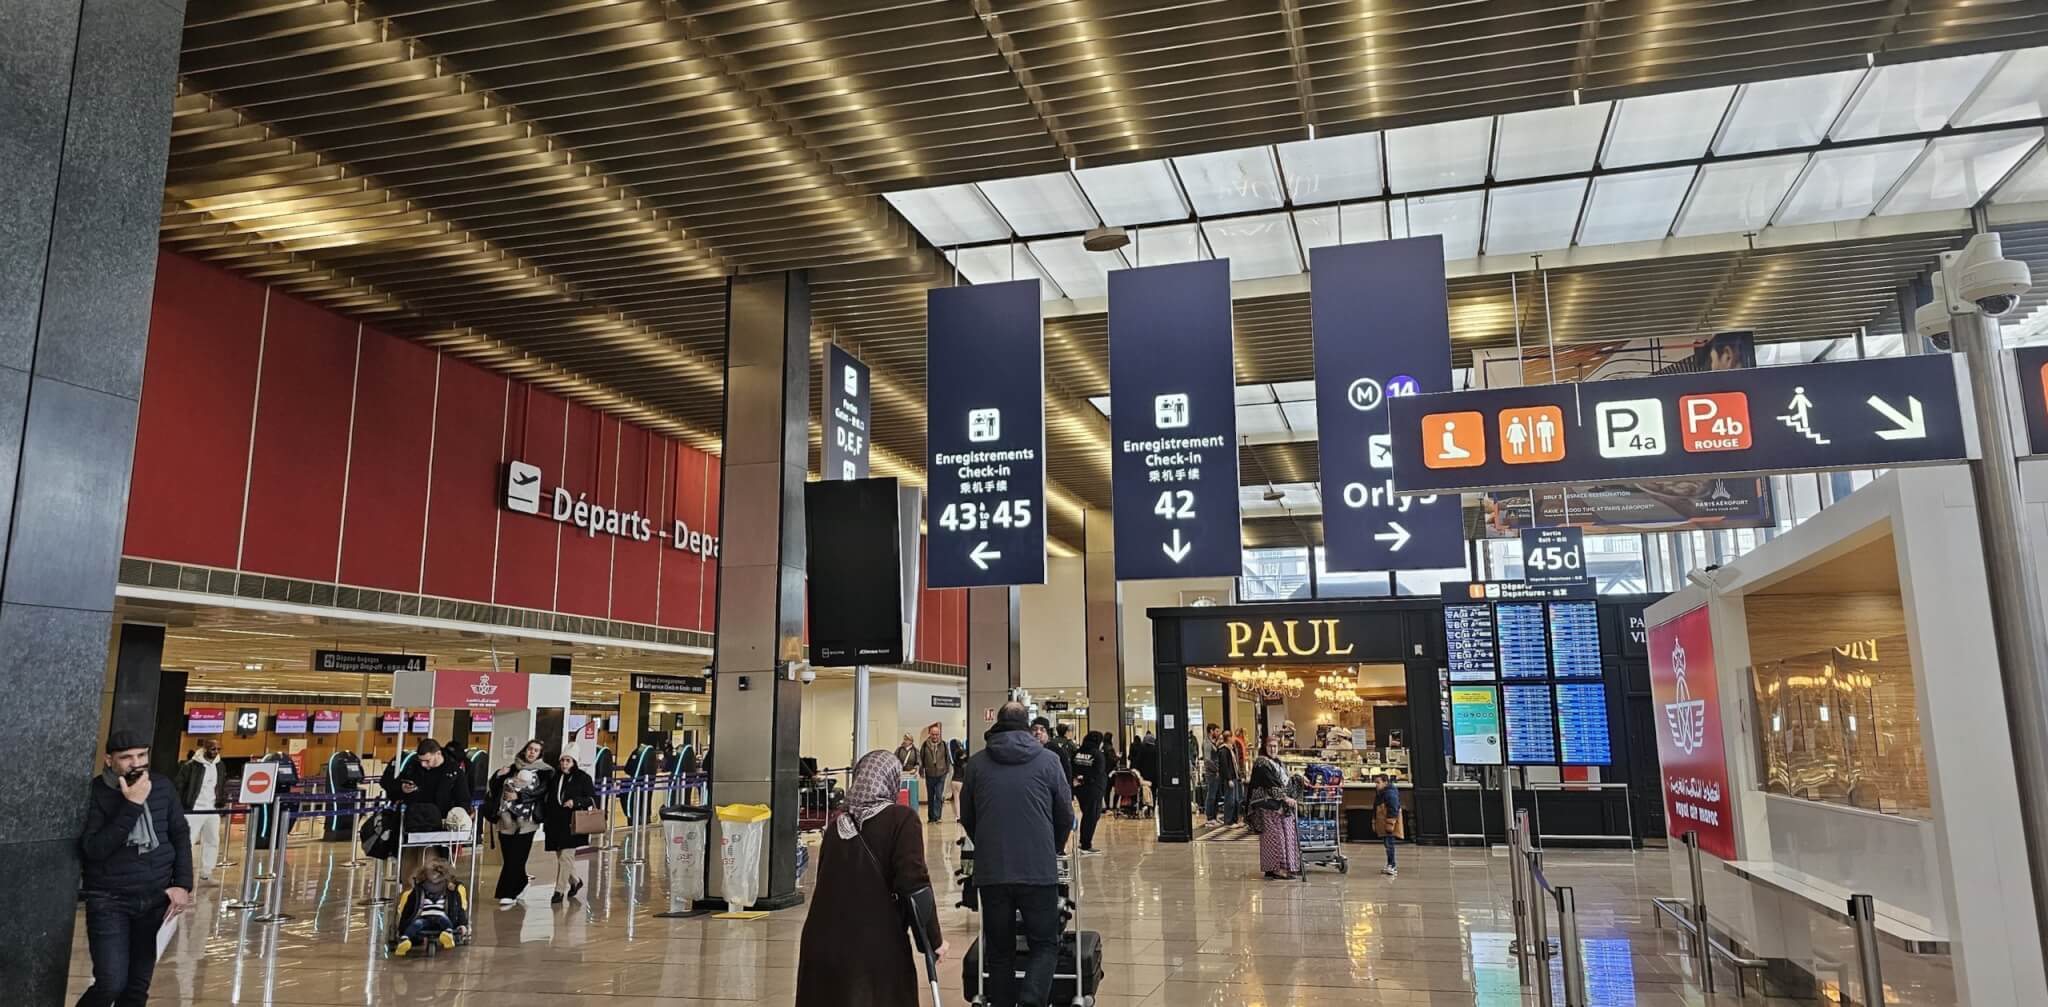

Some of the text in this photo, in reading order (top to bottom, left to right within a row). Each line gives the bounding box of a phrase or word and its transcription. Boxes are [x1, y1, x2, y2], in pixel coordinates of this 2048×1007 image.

[1388, 382, 1416, 397] 14
[1123, 435, 1225, 453] Enregistrement
[1694, 438, 1740, 449] ROUGE
[935, 448, 1035, 466] Enregistrements
[1145, 451, 1202, 467] Check-in
[958, 464, 1011, 478] Check-in
[1154, 489, 1196, 520] 42
[552, 487, 651, 541] Départs
[939, 502, 977, 531] 43
[992, 499, 1032, 528] 45
[1527, 544, 1580, 571] 45d
[1501, 590, 1546, 599] Departures
[1226, 618, 1355, 658] PAUL
[407, 658, 421, 671] 44
[238, 711, 257, 729] 43
